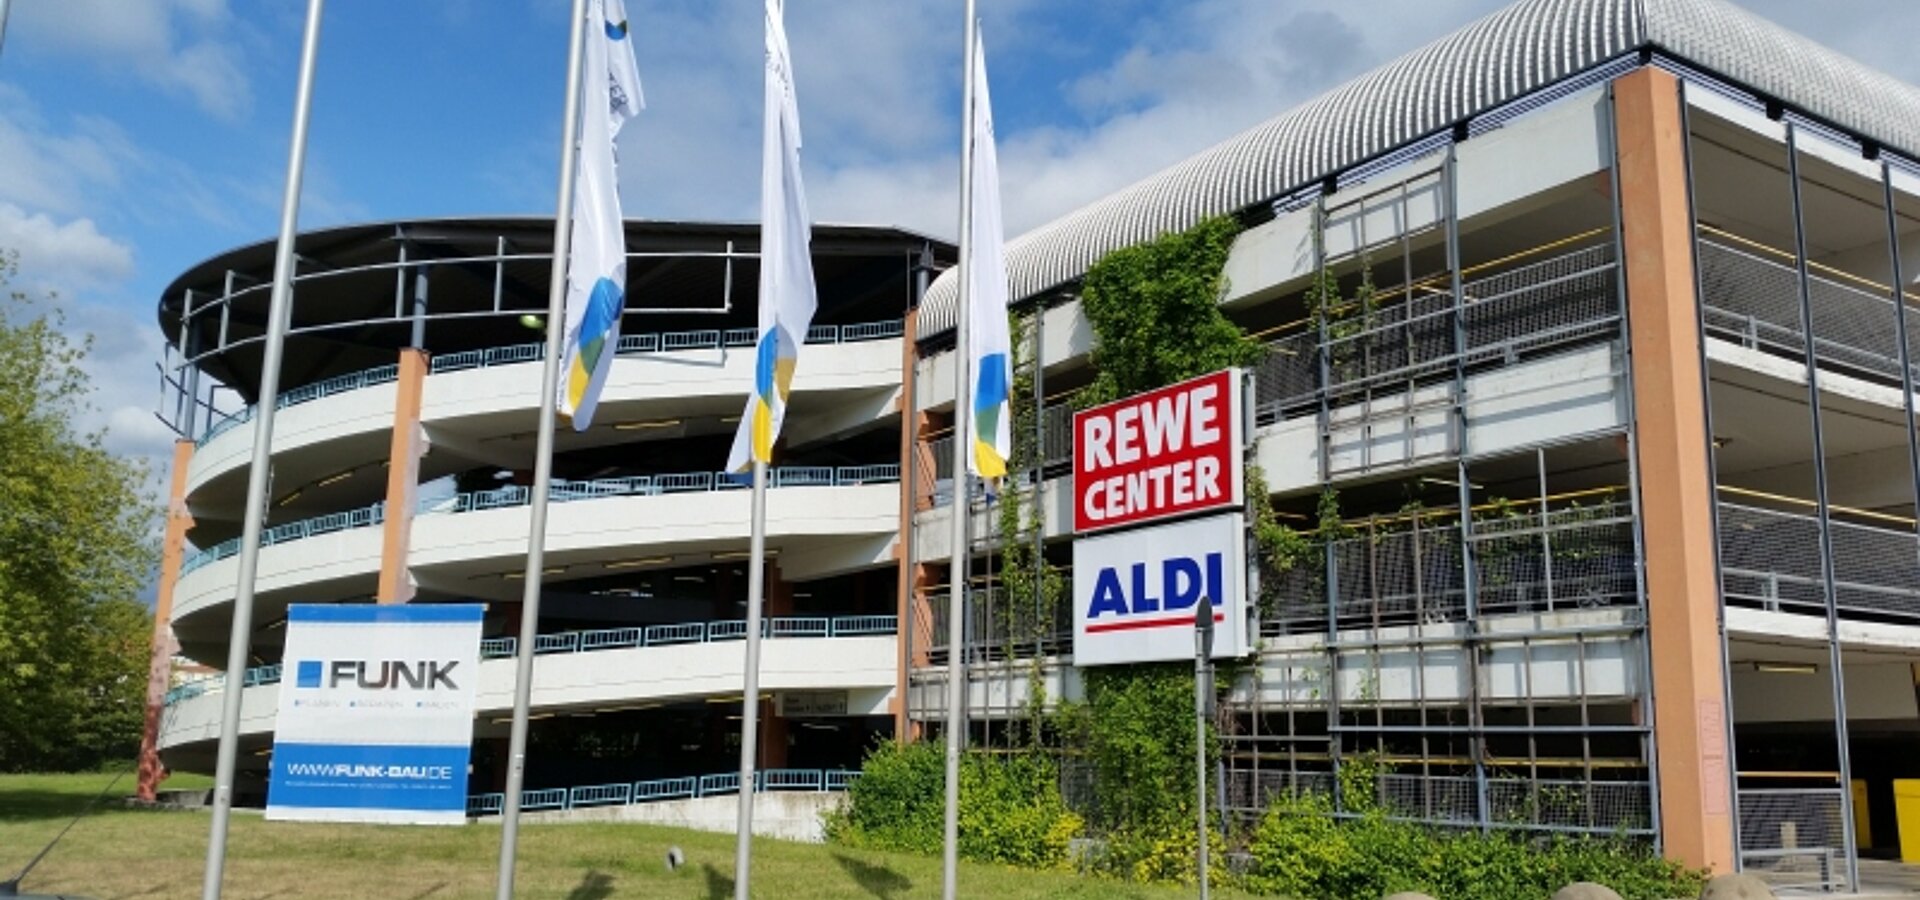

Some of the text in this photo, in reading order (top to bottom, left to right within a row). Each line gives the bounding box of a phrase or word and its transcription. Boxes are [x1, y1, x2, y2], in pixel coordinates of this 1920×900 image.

[1084, 383, 1220, 472] REWE
[1084, 456, 1221, 521] CENTER
[1087, 552, 1222, 618] ALDI
[329, 661, 459, 689] FUNK
